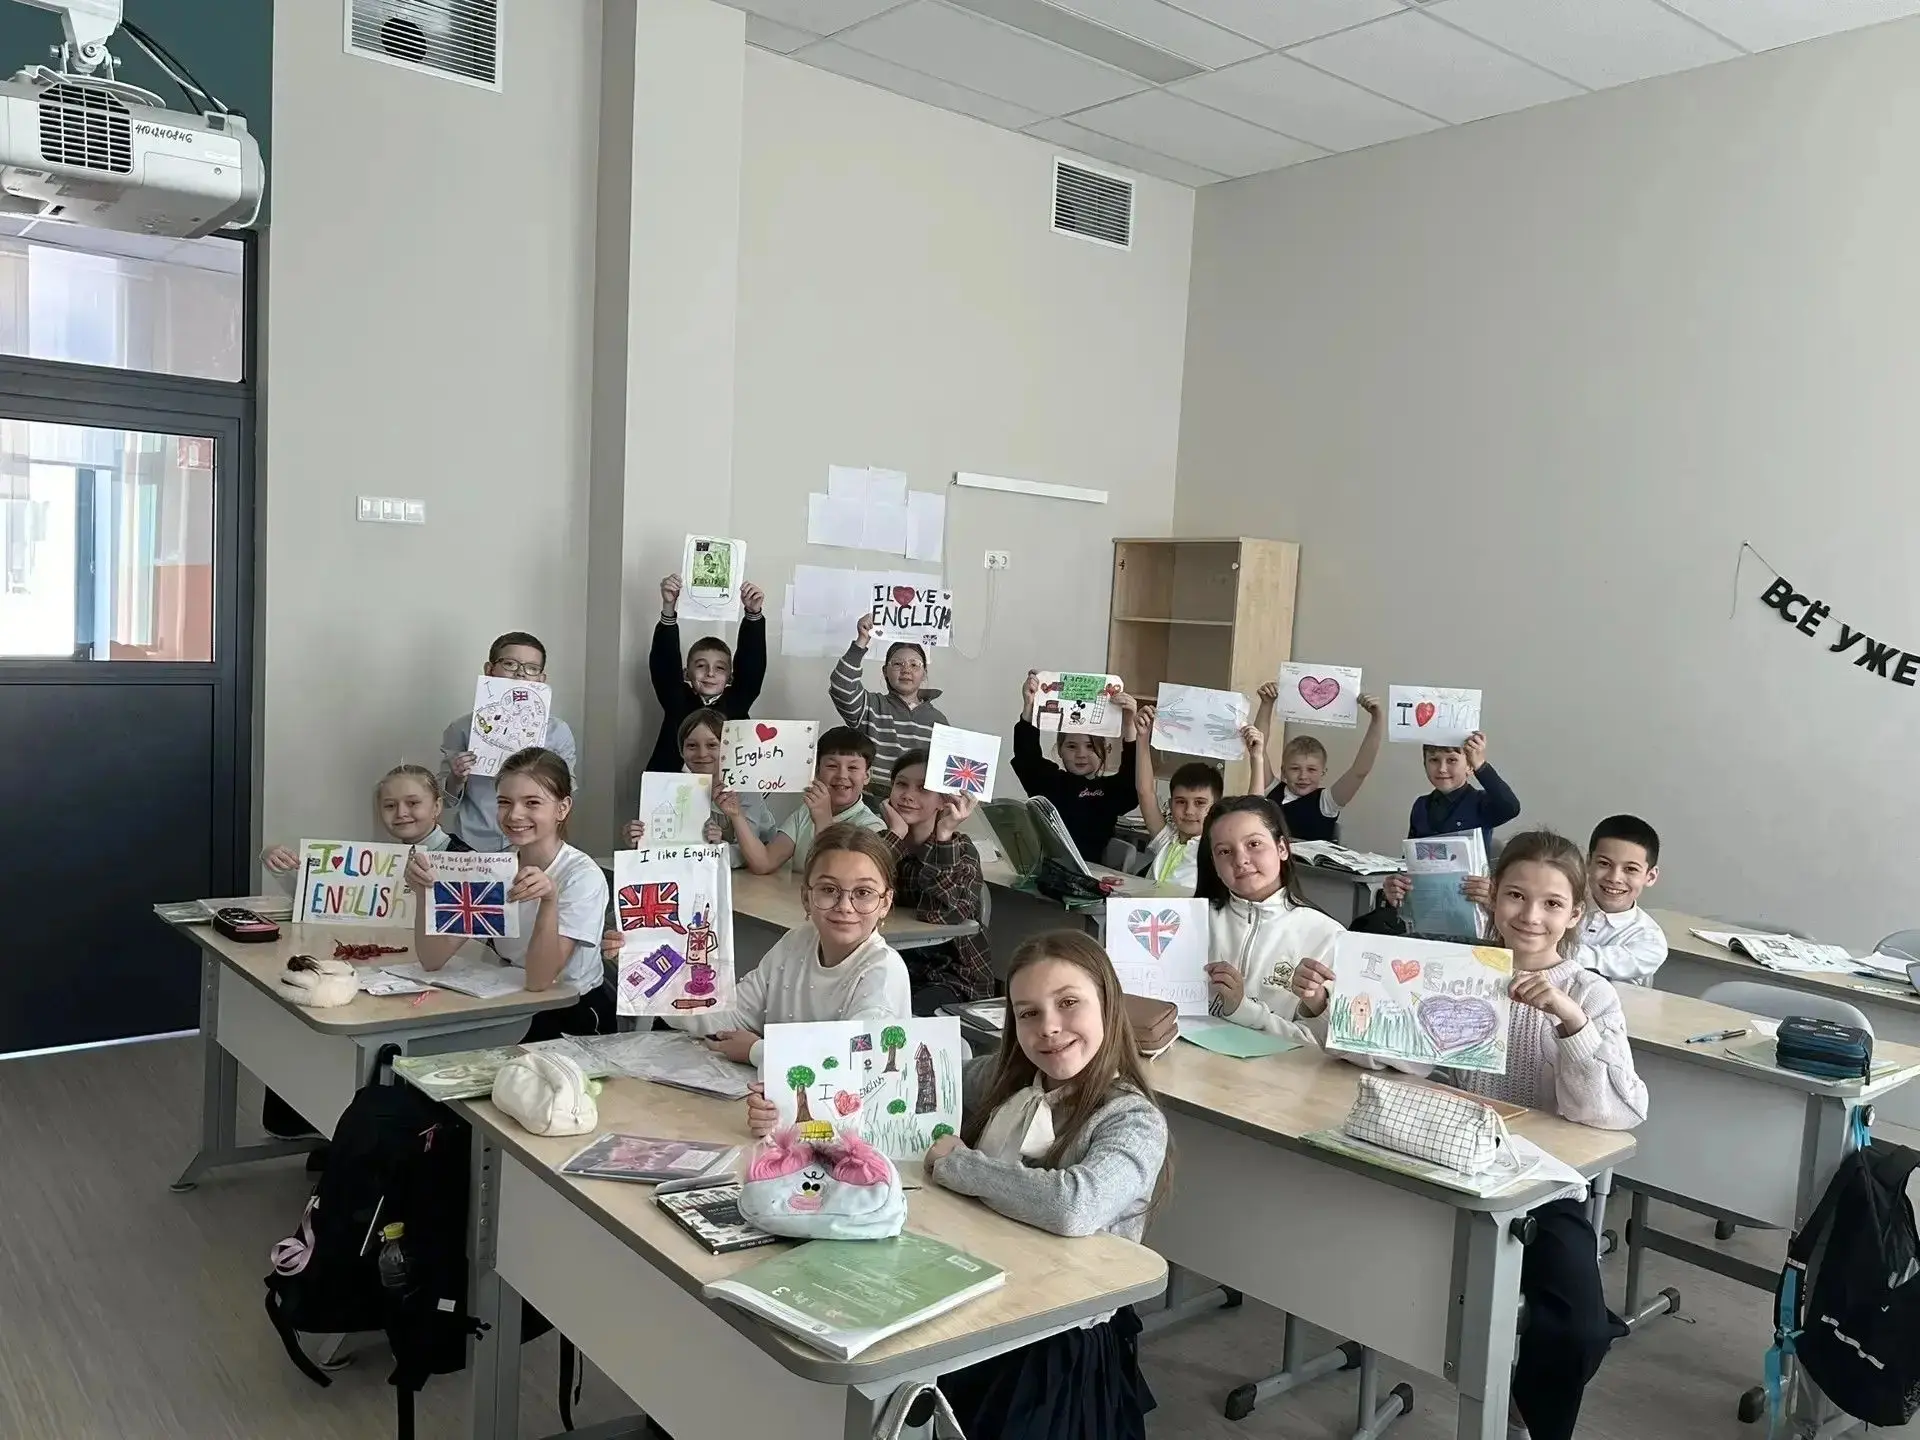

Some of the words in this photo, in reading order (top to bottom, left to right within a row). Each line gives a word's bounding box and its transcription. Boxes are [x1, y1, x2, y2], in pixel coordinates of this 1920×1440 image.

[874, 585, 884, 602] I
[872, 604, 952, 629] ENGLISH
[1761, 576, 1830, 638] ВСЁ
[1829, 623, 1920, 687] УЖЕ
[1397, 702, 1413, 726] I
[735, 745, 784, 767] English
[307, 843, 343, 875] I
[344, 845, 402, 878] LOVE
[640, 849, 651, 863] I
[657, 850, 678, 861] like
[1360, 951, 1383, 982] I
[818, 1083, 834, 1101] I
